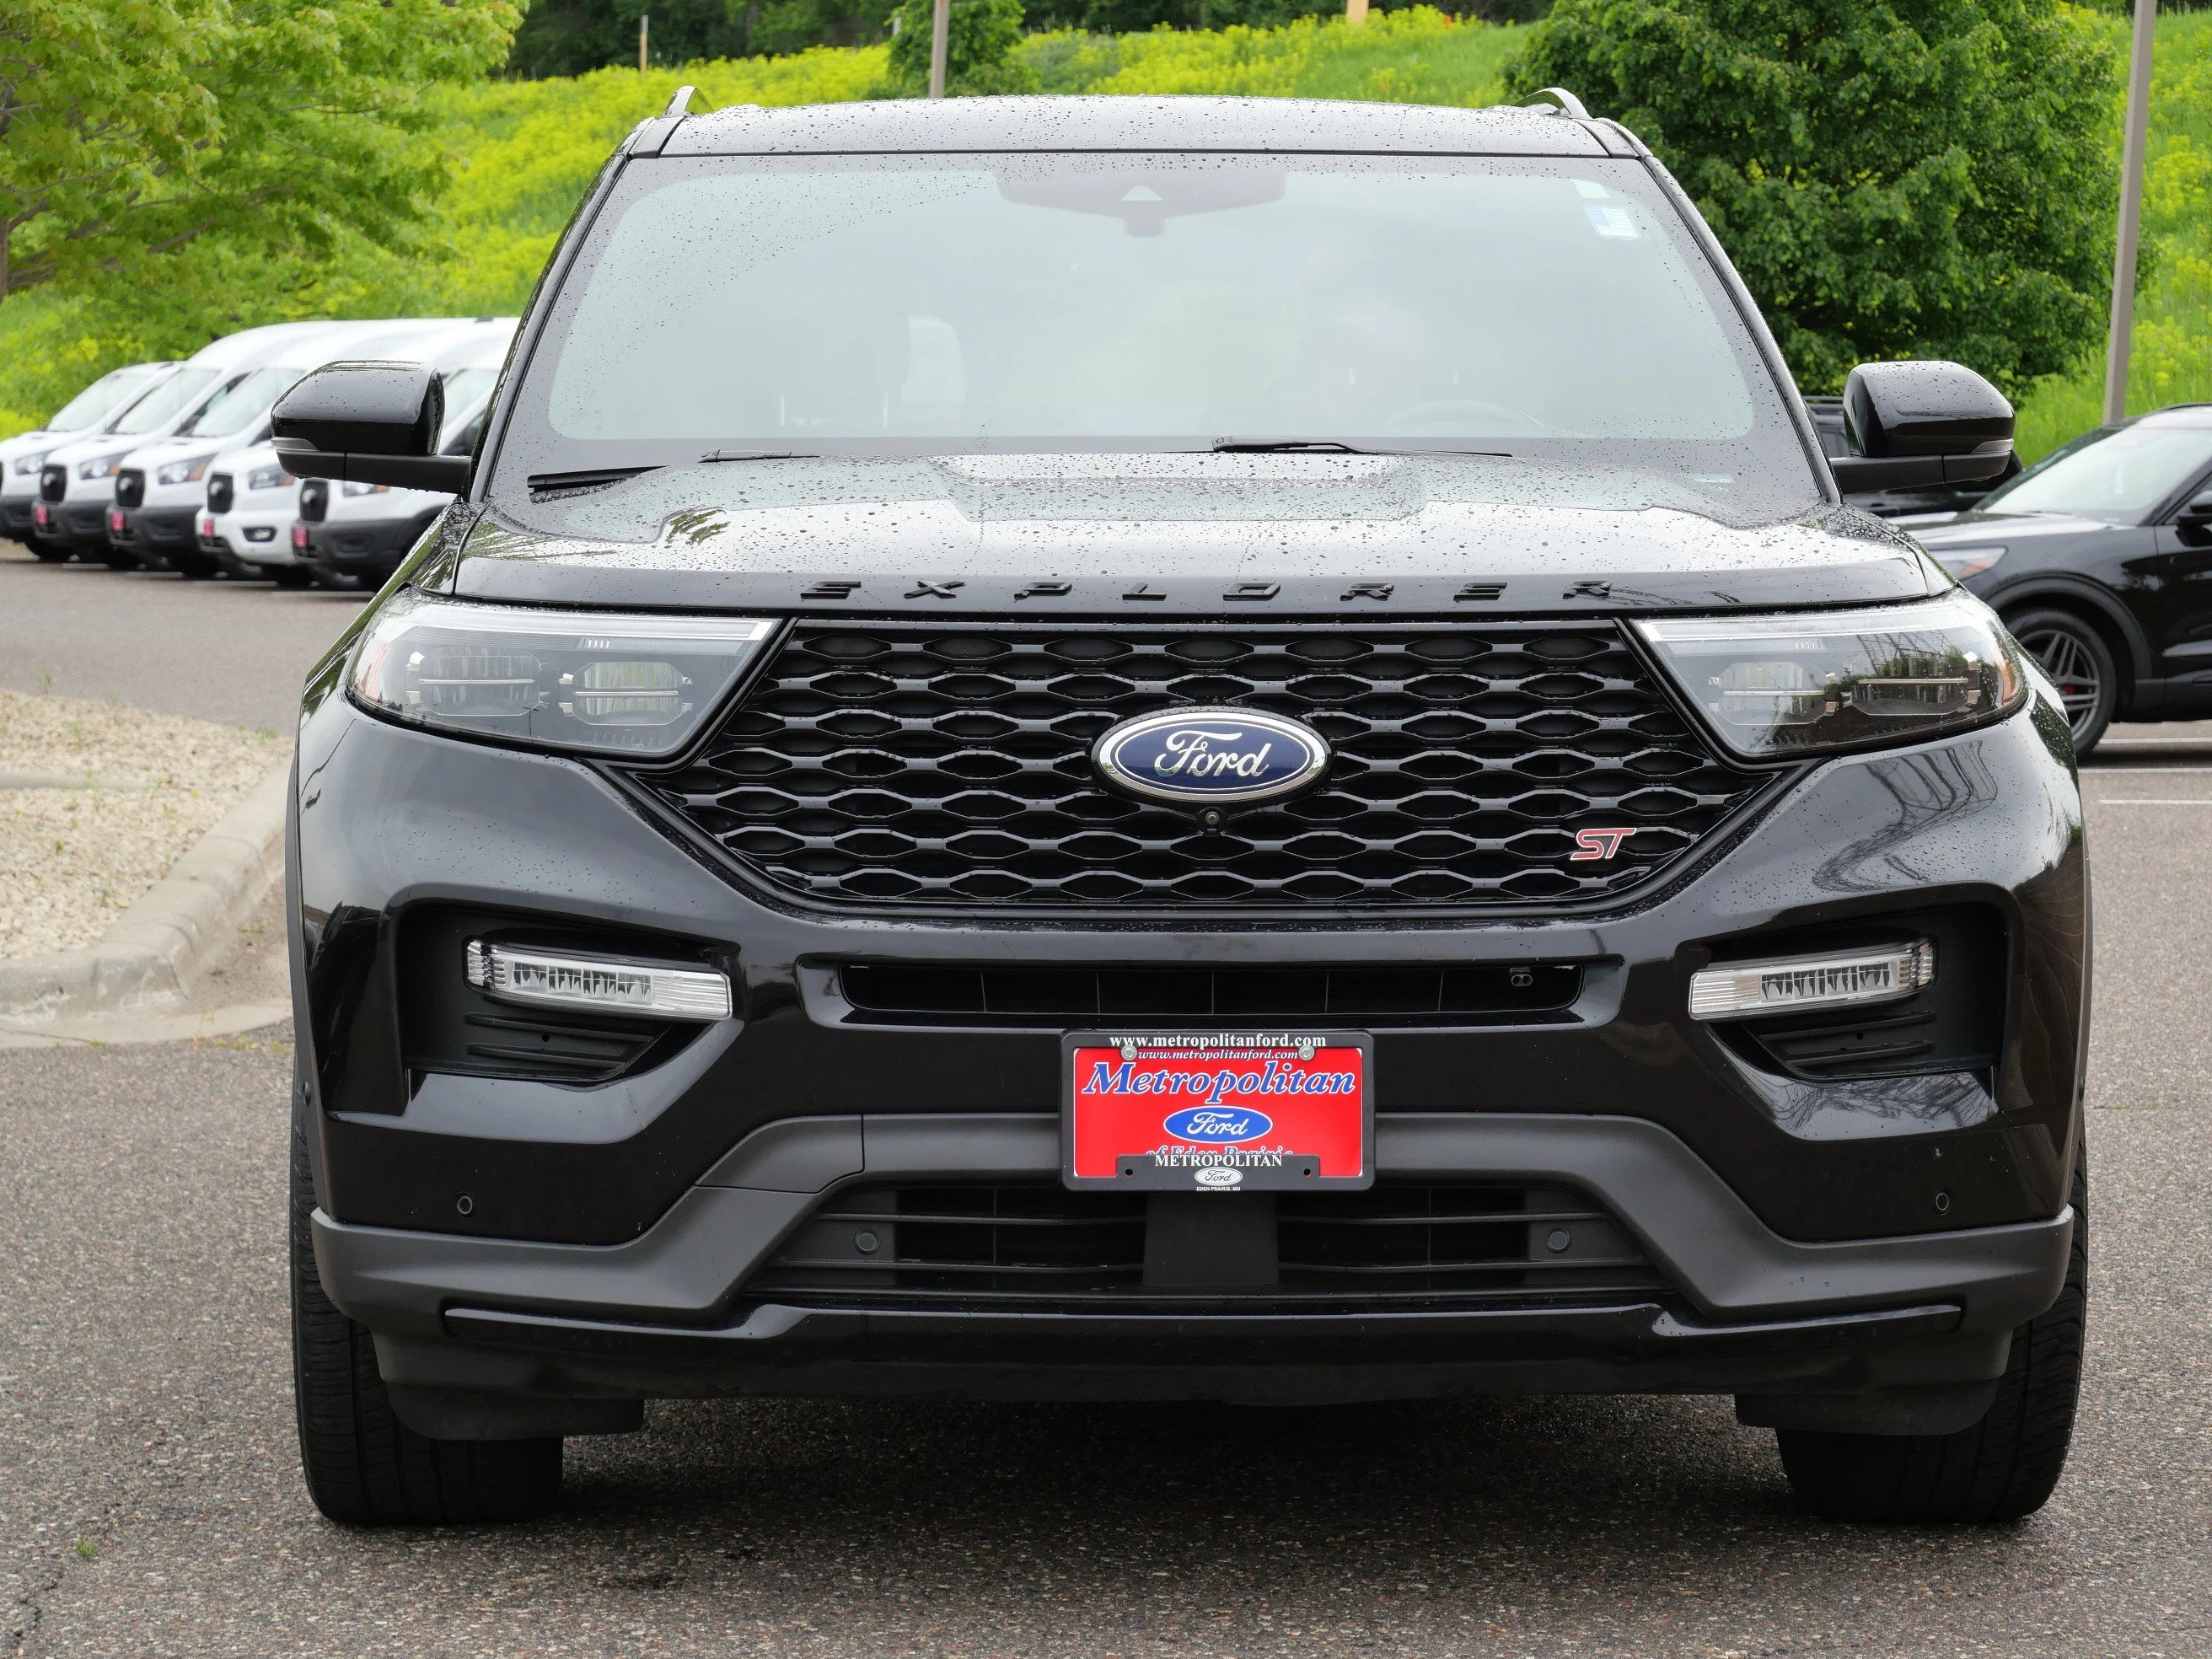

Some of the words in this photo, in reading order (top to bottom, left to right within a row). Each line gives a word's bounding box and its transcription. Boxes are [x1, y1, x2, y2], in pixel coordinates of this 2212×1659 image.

[800, 579, 1613, 602] EXPLORER
[1154, 730, 1272, 777] Ford
[1570, 827, 1637, 861] ST
[1109, 1034, 1327, 1050] www.metropolitanford.com
[1138, 1049, 1298, 1061] www.metropolitanford.com
[1082, 1060, 1356, 1104] Metropolitan
[1186, 1112, 1248, 1136] Ford
[1155, 1154, 1282, 1167] METROPOLITAN
[1205, 1169, 1232, 1182] Ford
